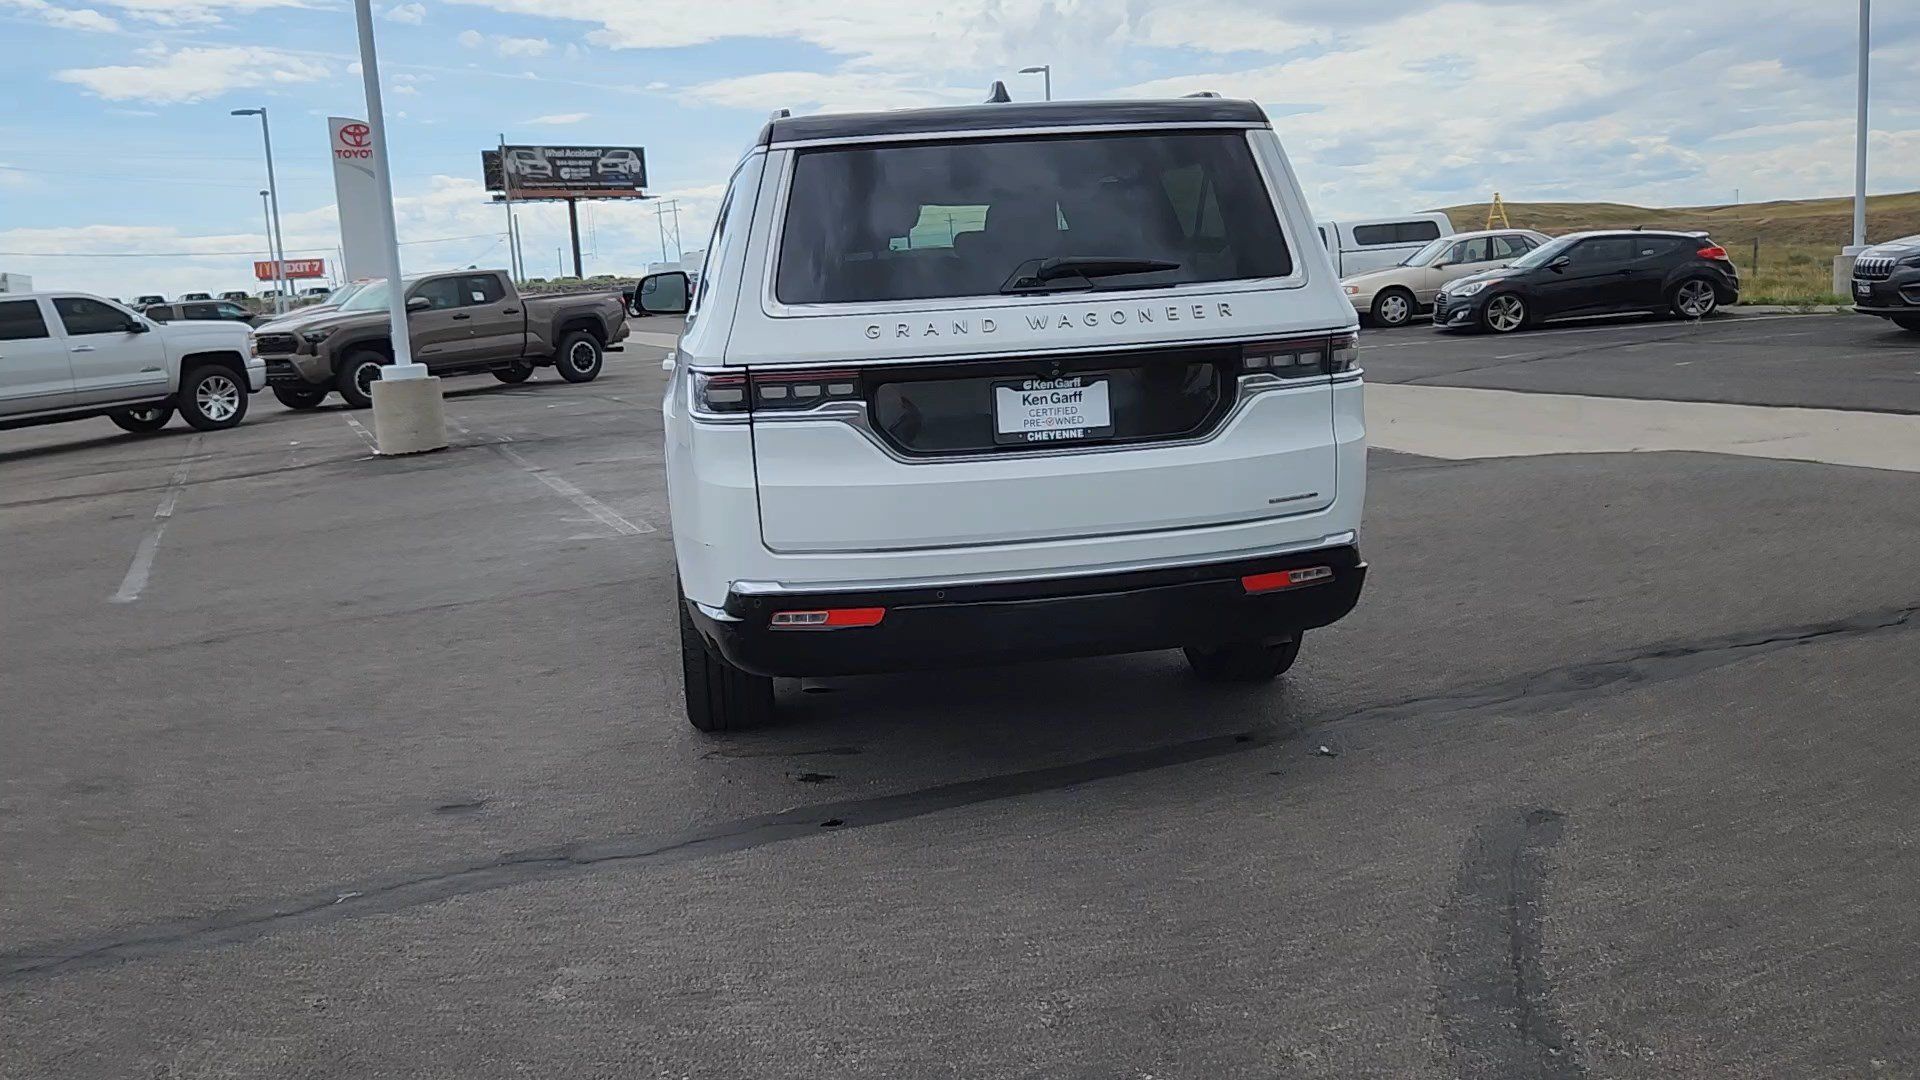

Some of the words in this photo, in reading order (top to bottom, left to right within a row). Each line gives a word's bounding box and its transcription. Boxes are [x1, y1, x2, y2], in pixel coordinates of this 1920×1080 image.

[335, 149, 374, 159] TOYOT
[544, 149, 565, 158] What
[565, 149, 602, 158] Accident?
[864, 316, 998, 339] GRAND
[1025, 302, 1233, 331] WAGONEER
[1032, 379, 1054, 390] Ken
[1054, 377, 1081, 389] Garff
[1022, 393, 1049, 406] Ken
[1050, 390, 1083, 404] Garff
[1028, 406, 1078, 417] CERTIFIED
[1027, 429, 1084, 441] CHEYENNE
